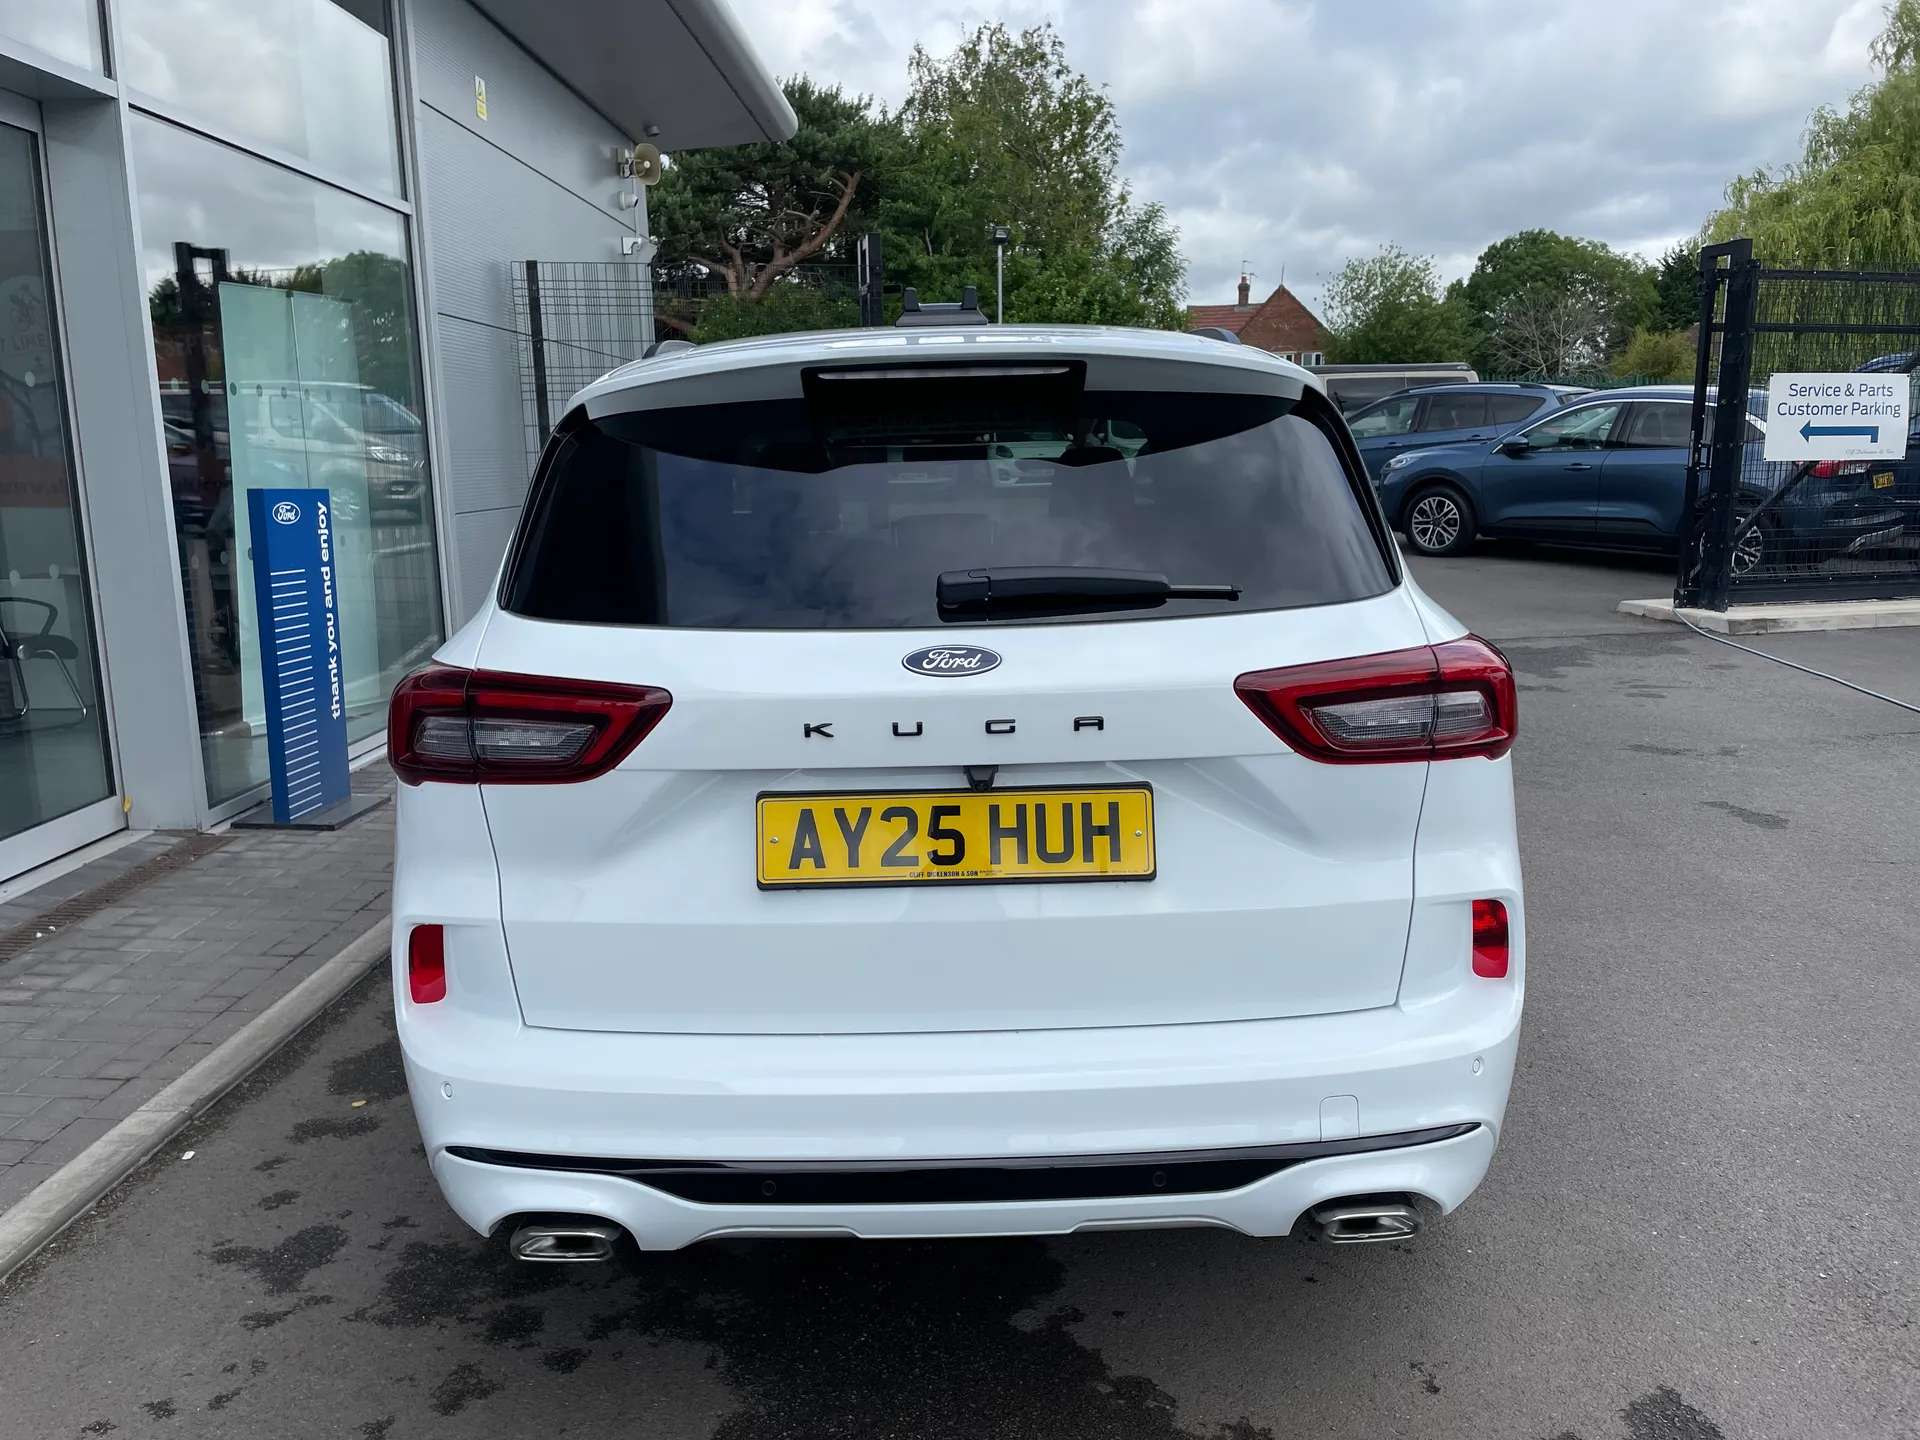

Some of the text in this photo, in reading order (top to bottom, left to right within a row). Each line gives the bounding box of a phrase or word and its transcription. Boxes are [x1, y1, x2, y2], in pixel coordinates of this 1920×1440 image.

[1788, 383, 1894, 397] Service & Parts
[1777, 402, 1901, 418] Customer Parking
[277, 504, 297, 521] Ford
[317, 501, 341, 720] thank you and enjoy
[922, 649, 982, 669] Ford
[803, 715, 1105, 739] KUGA
[788, 802, 1121, 870] AY25 HUH
